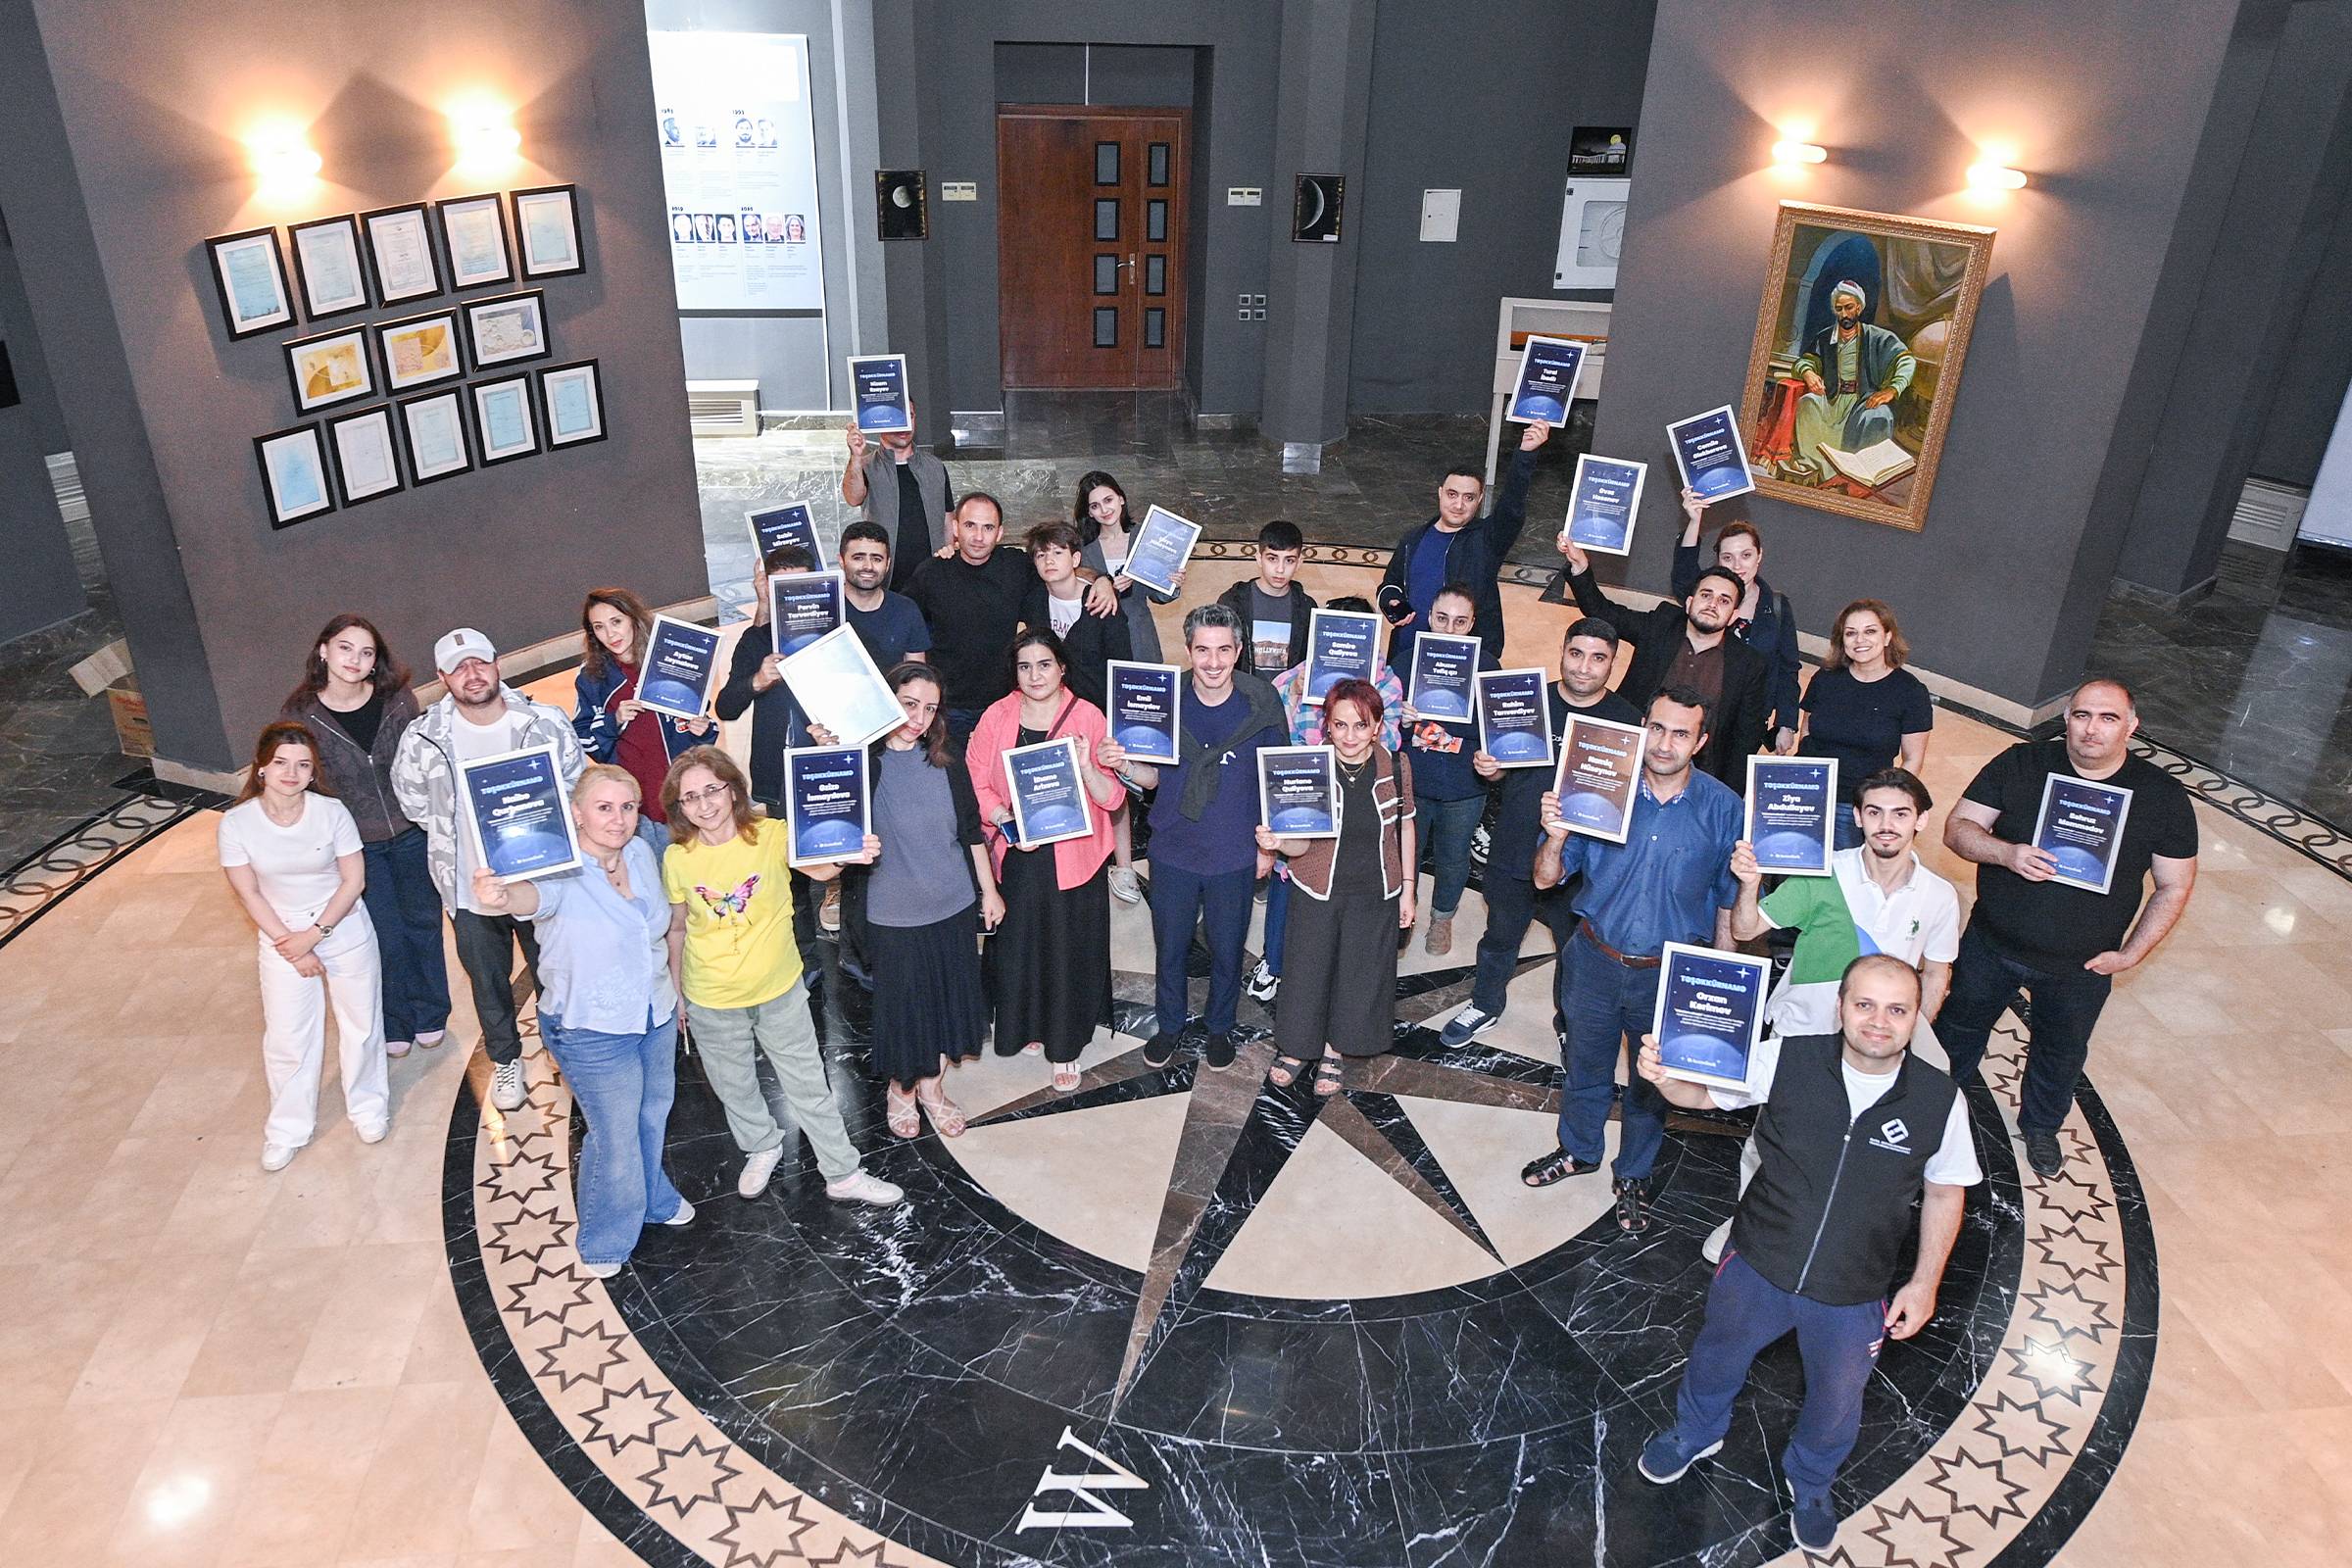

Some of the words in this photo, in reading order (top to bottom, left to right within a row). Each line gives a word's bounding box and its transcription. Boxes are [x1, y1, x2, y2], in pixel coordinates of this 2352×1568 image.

[1121, 683, 1166, 692] TƏŞƏKKÜRNAMƏ
[1490, 690, 1534, 699] TƏŞƏKKÜRNAMƏ
[802, 769, 854, 781] TƏŞƏKKÜRNAMƏ
[1782, 794, 1801, 804] Ziya
[1767, 803, 1815, 813] Abdullayev
[1680, 974, 1746, 993] TƏŞƏKKÜRNAMƏ
[1695, 991, 1728, 1004] Orxan
[1014, 1425, 1150, 1536] W
